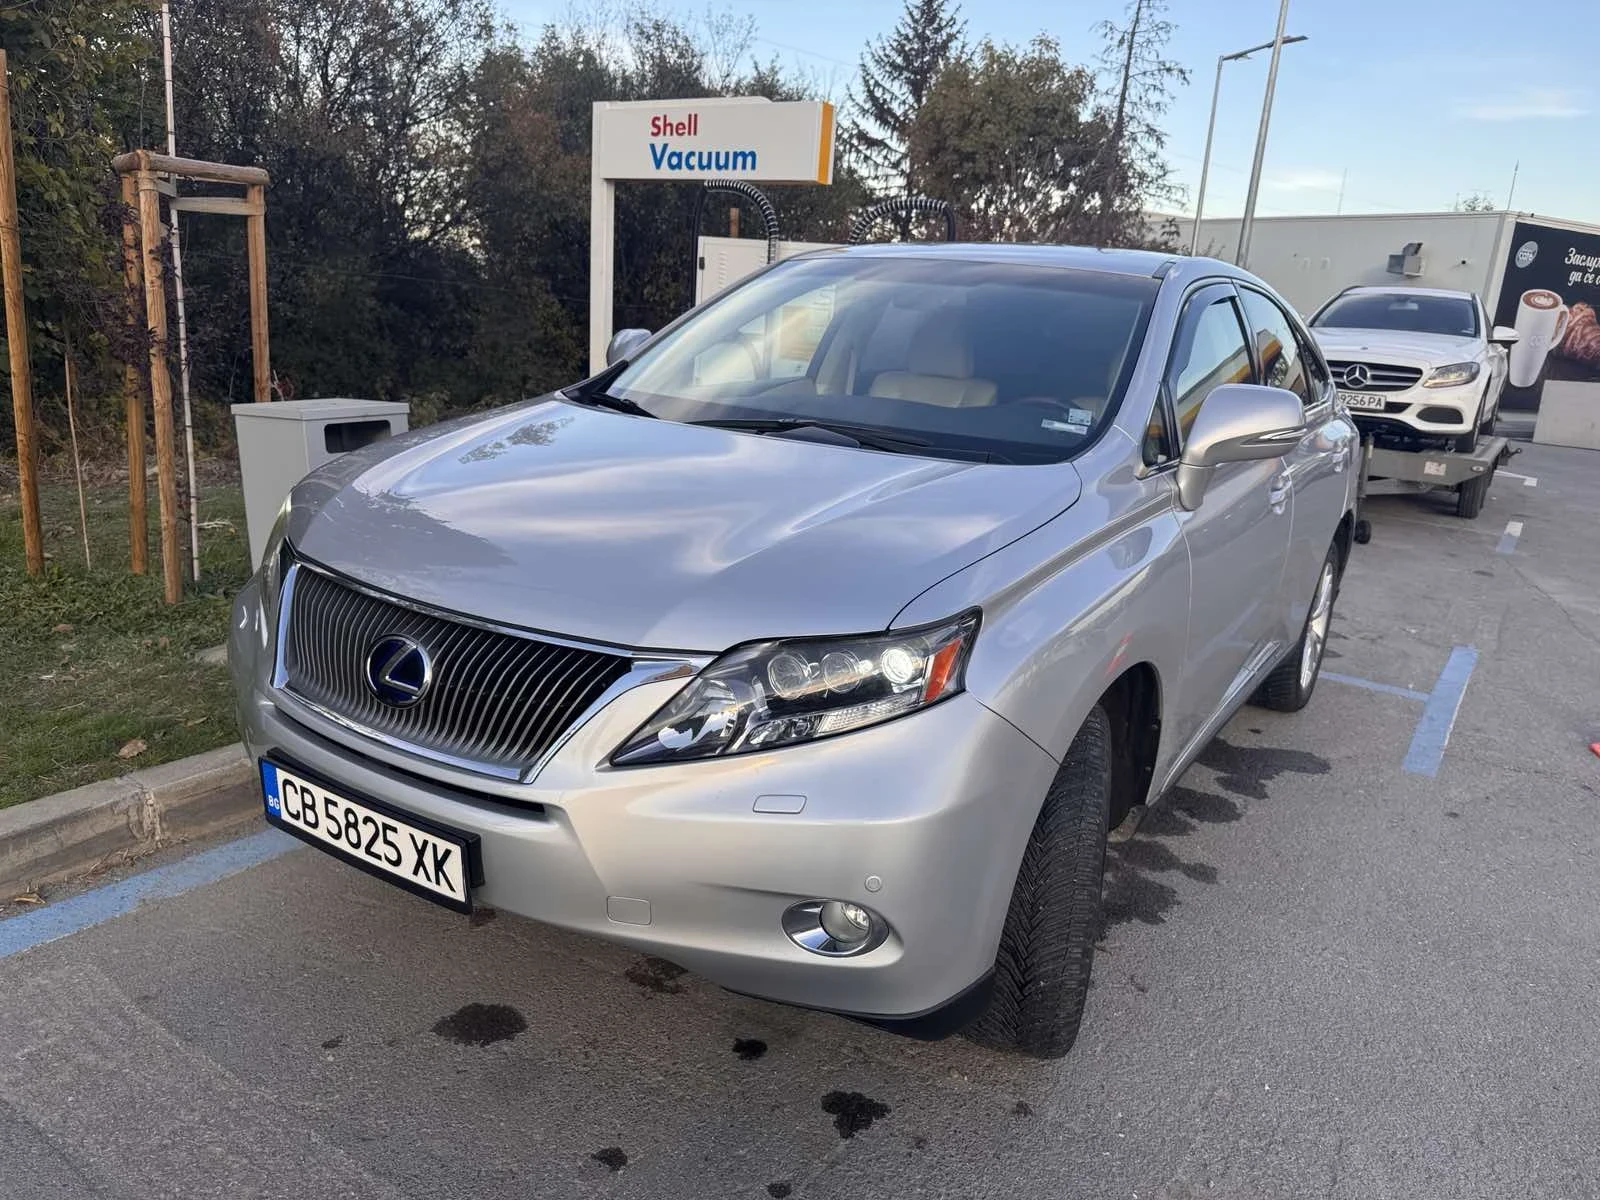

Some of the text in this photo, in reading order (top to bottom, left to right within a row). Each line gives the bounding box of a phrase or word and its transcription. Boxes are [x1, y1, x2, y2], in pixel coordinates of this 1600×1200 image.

[650, 113, 698, 137] Shell
[649, 143, 757, 171] Vacuum
[1341, 394, 1382, 407] 9256 PA
[268, 794, 280, 810] BG
[282, 778, 456, 893] CB 5825 XK
